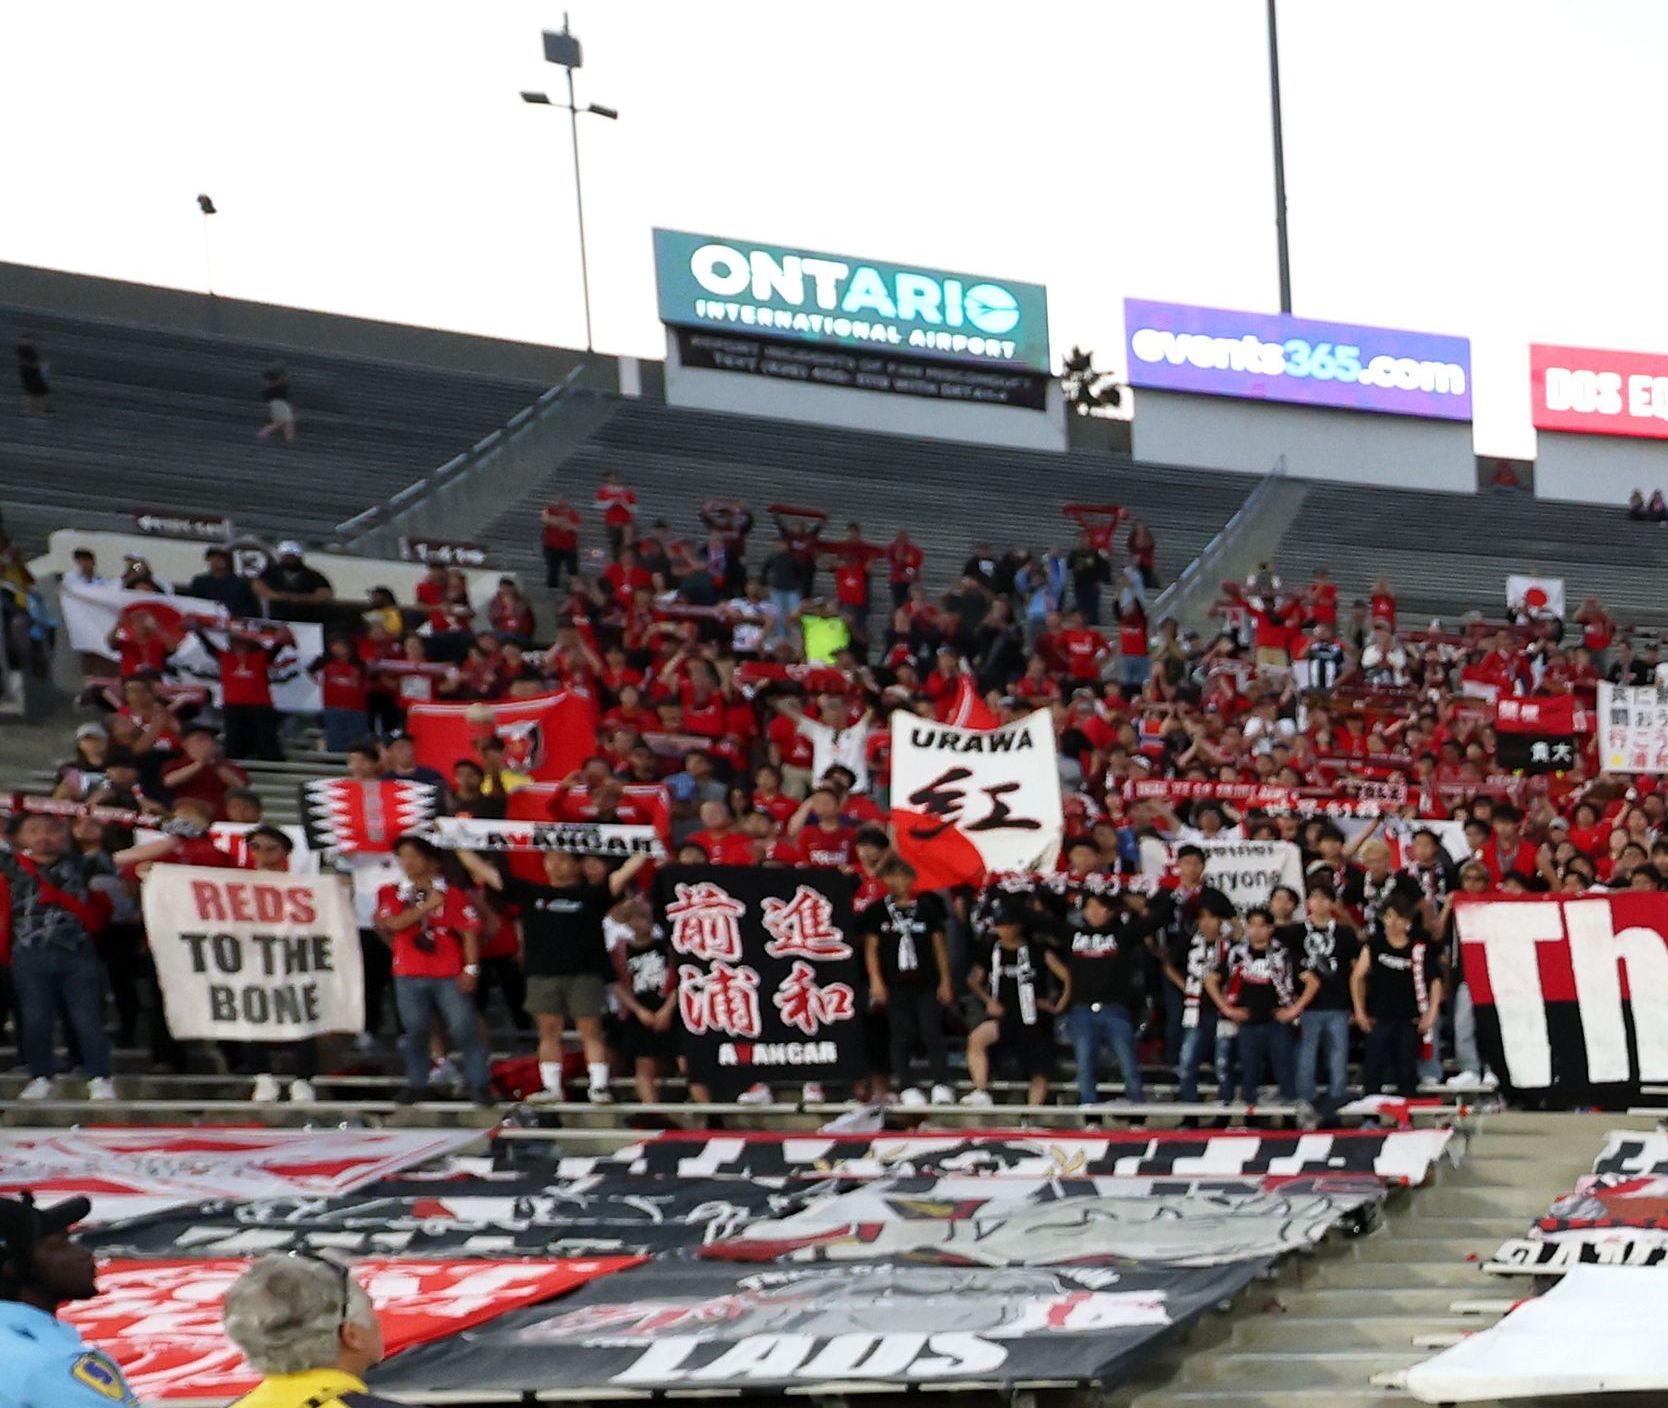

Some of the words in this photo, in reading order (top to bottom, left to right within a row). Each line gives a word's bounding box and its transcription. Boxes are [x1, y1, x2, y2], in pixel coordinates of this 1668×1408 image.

[689, 243, 1020, 334] ONTARIO
[695, 299, 902, 346] INTERNATIONAL
[908, 327, 1018, 360] AIRPORT
[1131, 327, 1466, 395] events365.com
[1545, 366, 1622, 415] DOS
[911, 728, 1033, 753] URAWA
[191, 879, 316, 924] REDS
[665, 881, 855, 963] 前進
[178, 932, 243, 974] TO
[252, 933, 335, 976] THE
[209, 982, 321, 1025] BONE
[677, 959, 855, 1039] 浦和
[610, 1332, 1008, 1384] LADS
